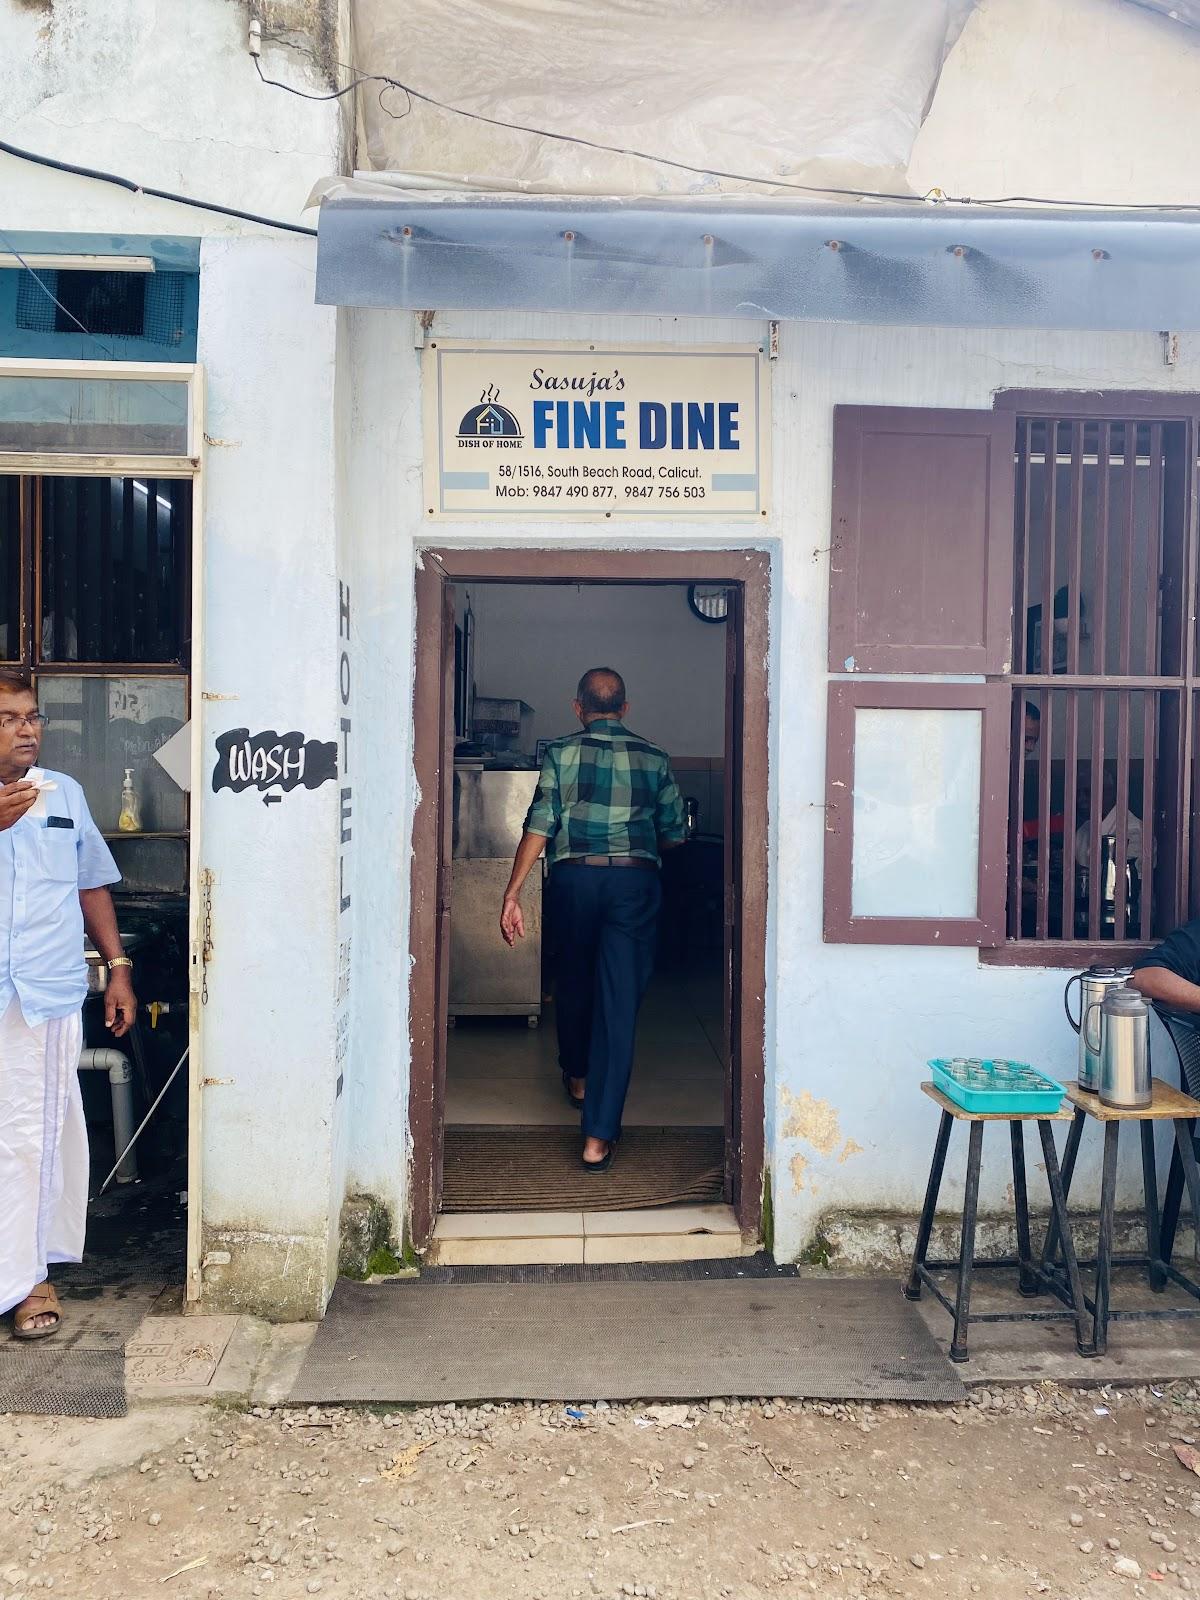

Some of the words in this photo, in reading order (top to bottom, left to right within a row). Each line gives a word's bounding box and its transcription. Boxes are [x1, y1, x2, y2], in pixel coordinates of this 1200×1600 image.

[529, 368, 626, 397] Sasuja's
[533, 400, 627, 450] FINE
[638, 401, 741, 451] DINE
[457, 439, 481, 448] DISH
[482, 439, 495, 449] OF
[496, 440, 523, 449] HOME
[498, 465, 544, 479] 58/1516,
[547, 465, 579, 478] South
[582, 465, 619, 479] Beach
[622, 466, 655, 480] Road,
[658, 466, 702, 479] Calicut.
[495, 485, 529, 498] Mob:
[532, 485, 562, 498] 9847
[566, 485, 589, 498] 490
[592, 485, 617, 500] 877,
[624, 485, 654, 498] 9847
[658, 486, 680, 499] 756
[683, 486, 706, 499] 503
[339, 579, 352, 914] HOTEL
[229, 740, 306, 783] WASH
